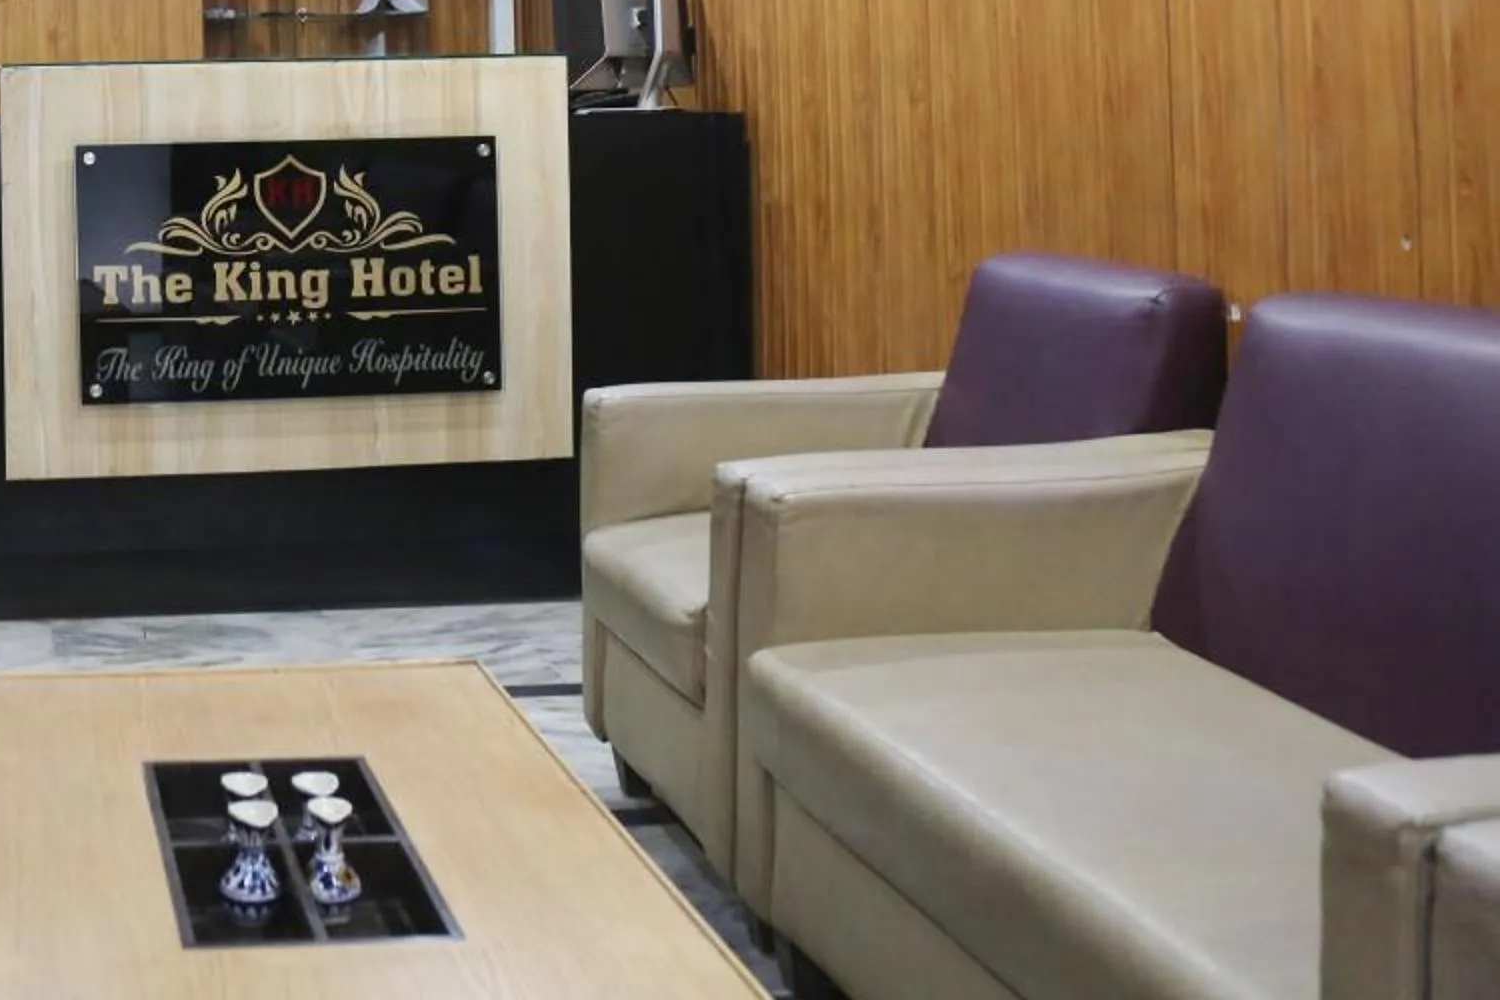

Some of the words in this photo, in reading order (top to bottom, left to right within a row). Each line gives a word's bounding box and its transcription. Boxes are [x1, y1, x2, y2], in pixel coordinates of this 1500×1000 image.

[93, 264, 193, 305] The
[213, 260, 330, 309] King
[350, 255, 482, 298] Hotel
[97, 346, 142, 382] The
[152, 345, 214, 392] King
[223, 346, 255, 392] of
[257, 343, 342, 390] Unique
[349, 336, 485, 386] Hospitality
